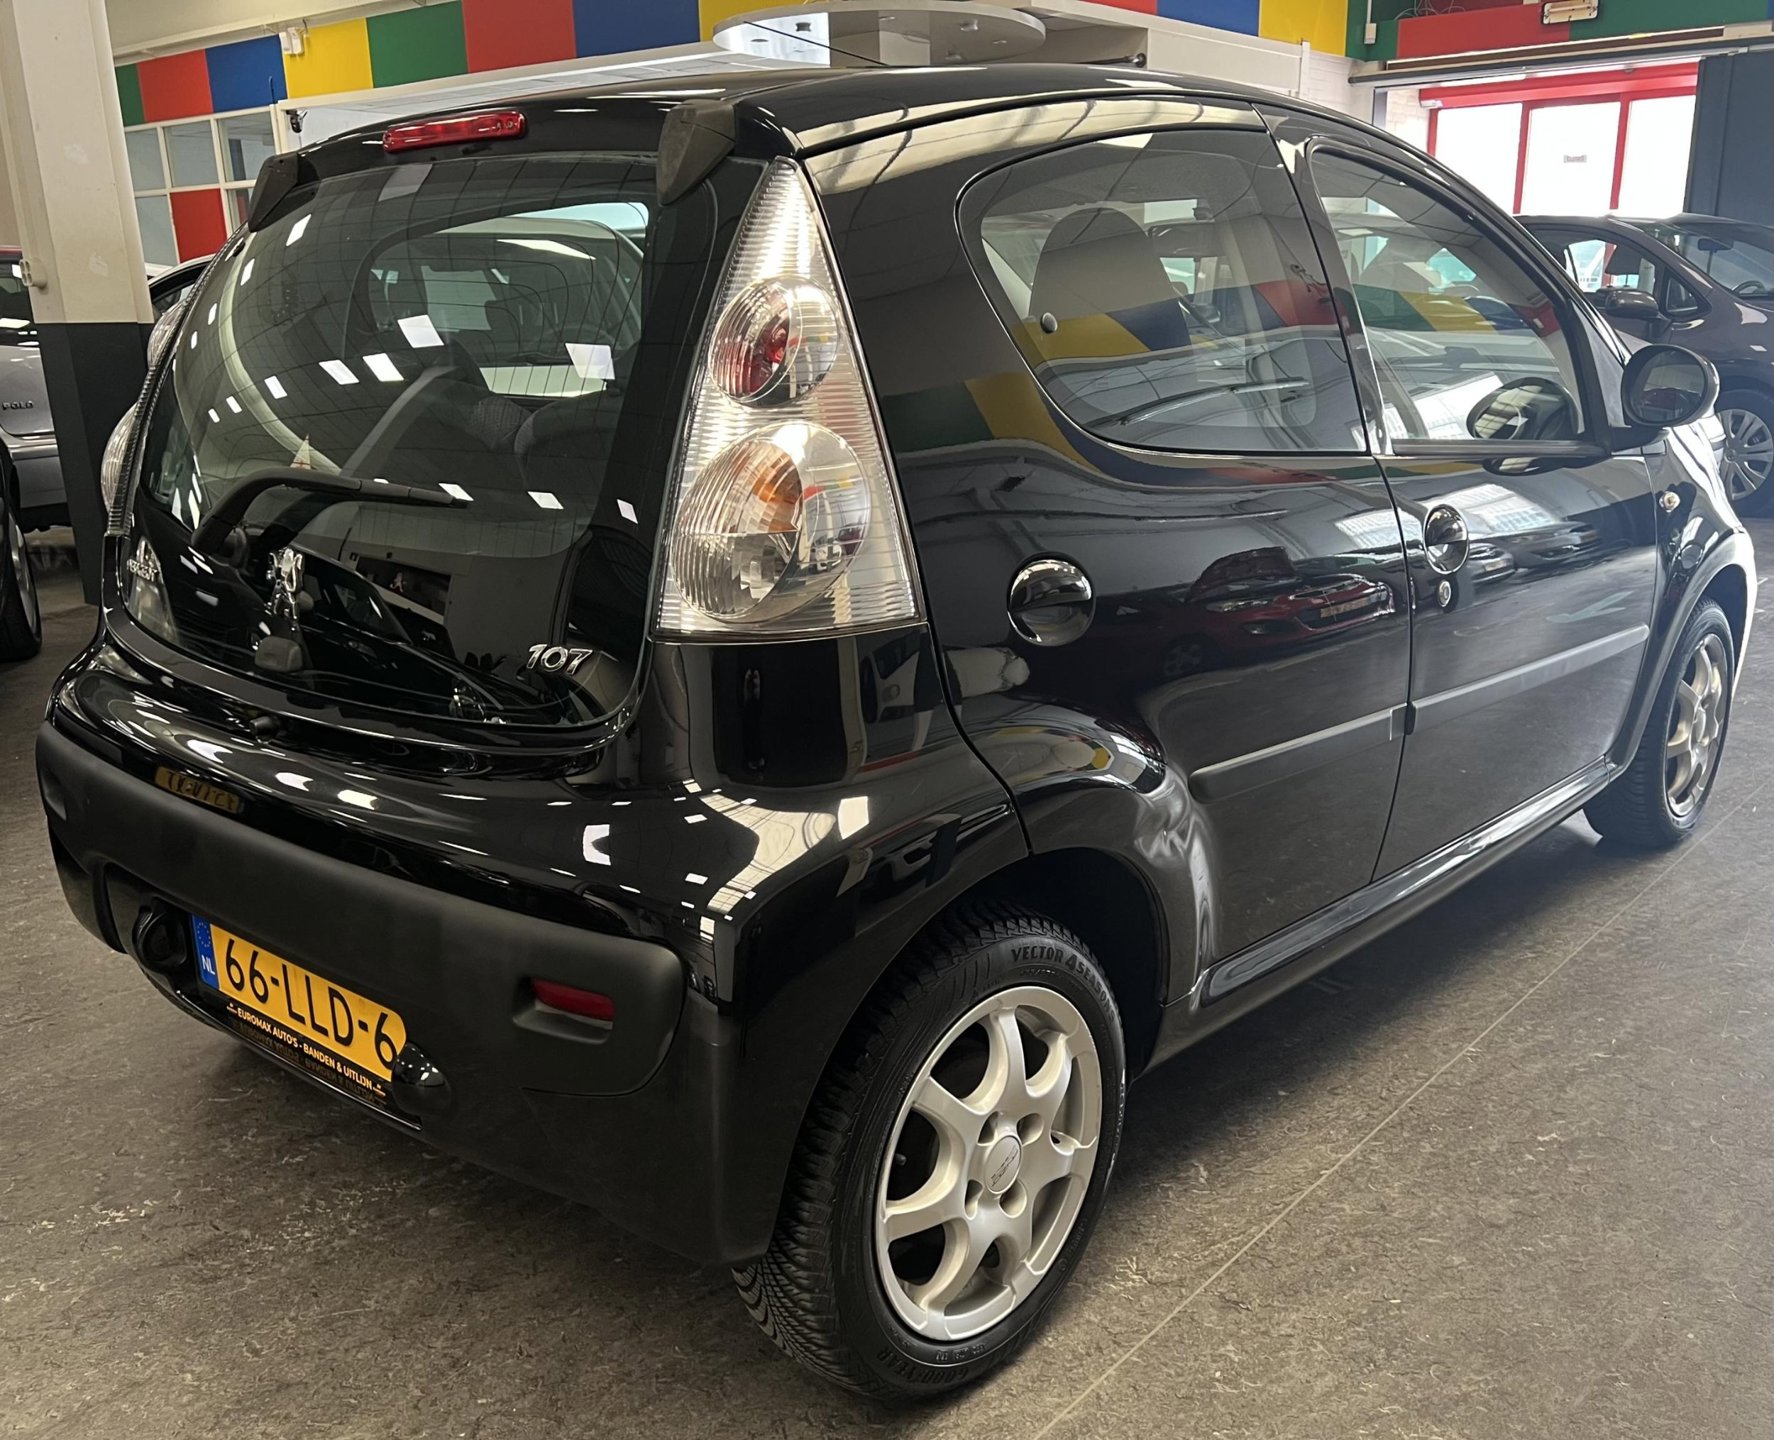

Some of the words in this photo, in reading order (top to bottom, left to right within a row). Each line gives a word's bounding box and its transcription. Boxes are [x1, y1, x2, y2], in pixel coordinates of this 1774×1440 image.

[2, 400, 34, 410] POLO
[526, 643, 594, 675] 107
[201, 954, 216, 975] NL
[1011, 945, 1064, 964] VECTOR
[225, 938, 399, 1071] 66-LLD-6
[237, 1007, 272, 1034] EUROMAX
[303, 1042, 336, 1070] BANDEN
